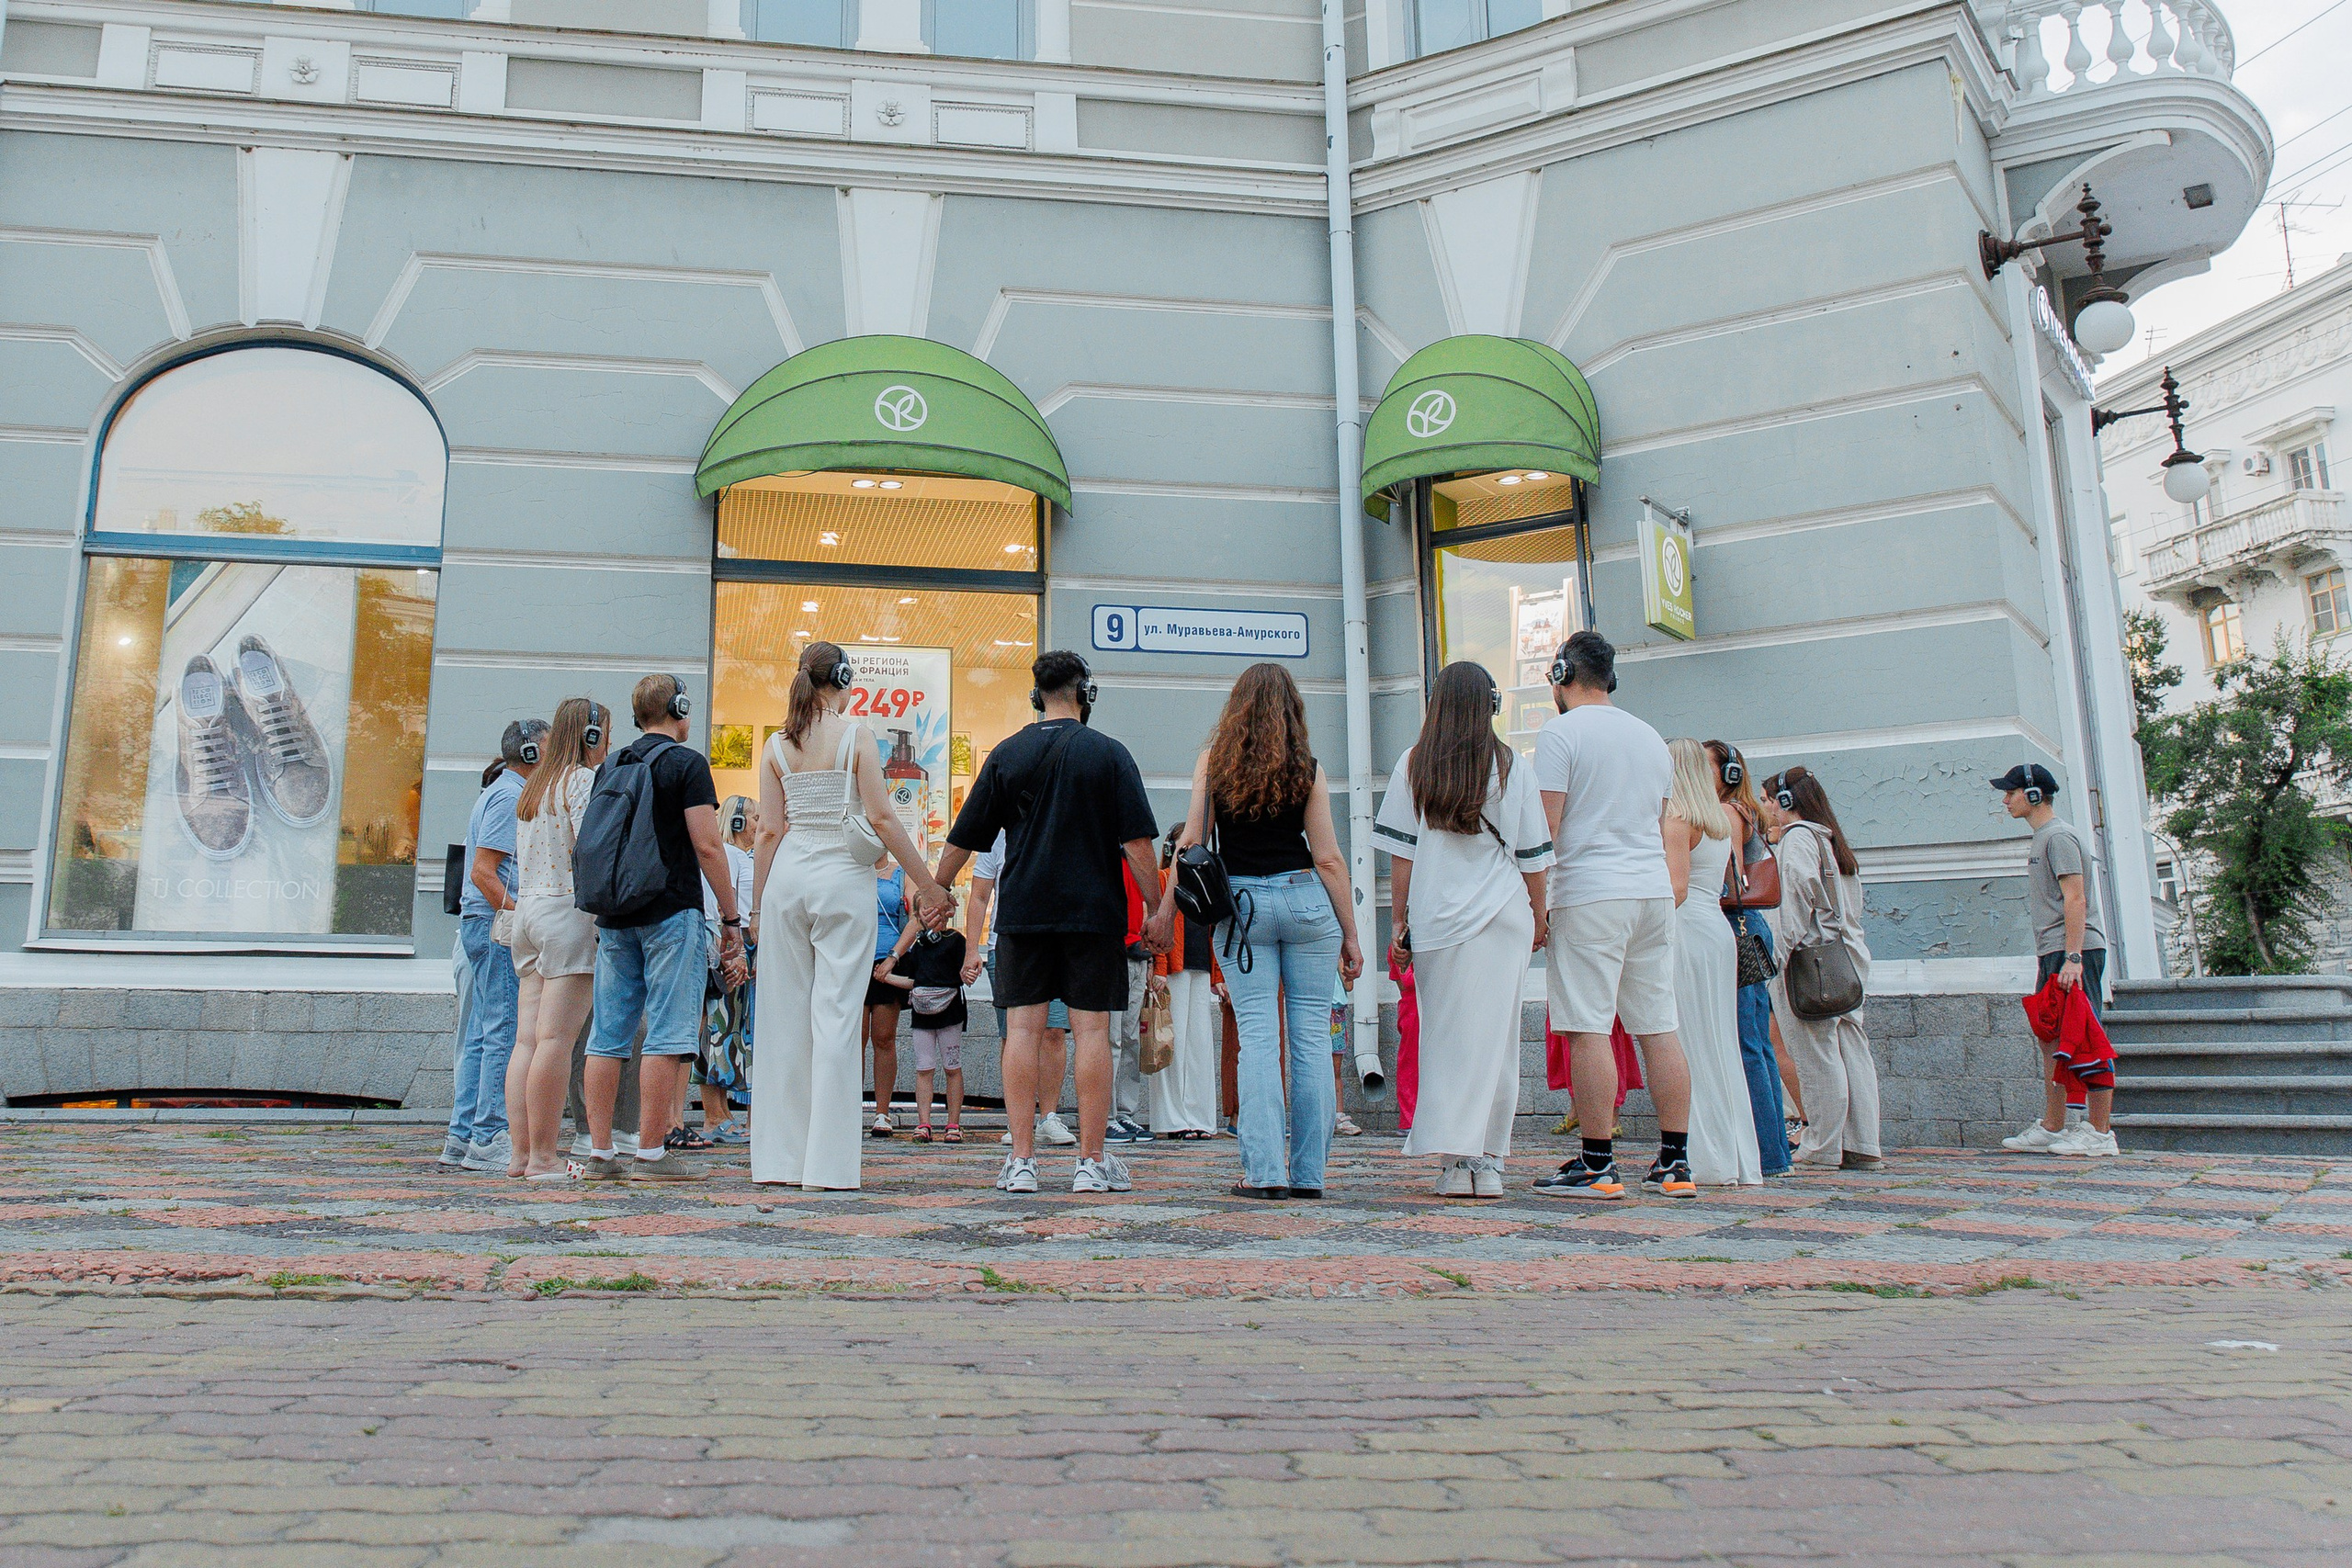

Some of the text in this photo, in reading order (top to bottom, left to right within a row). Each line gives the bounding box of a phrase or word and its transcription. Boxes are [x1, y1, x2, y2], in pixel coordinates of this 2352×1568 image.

[1106, 614, 1301, 643] 9 ул. Муравьева-Амурского
[848, 656, 910, 667] Ы РЕГИОНА
[859, 666, 910, 676] ФРАНЦИЯ
[151, 877, 321, 900] TJ COLLECTION
